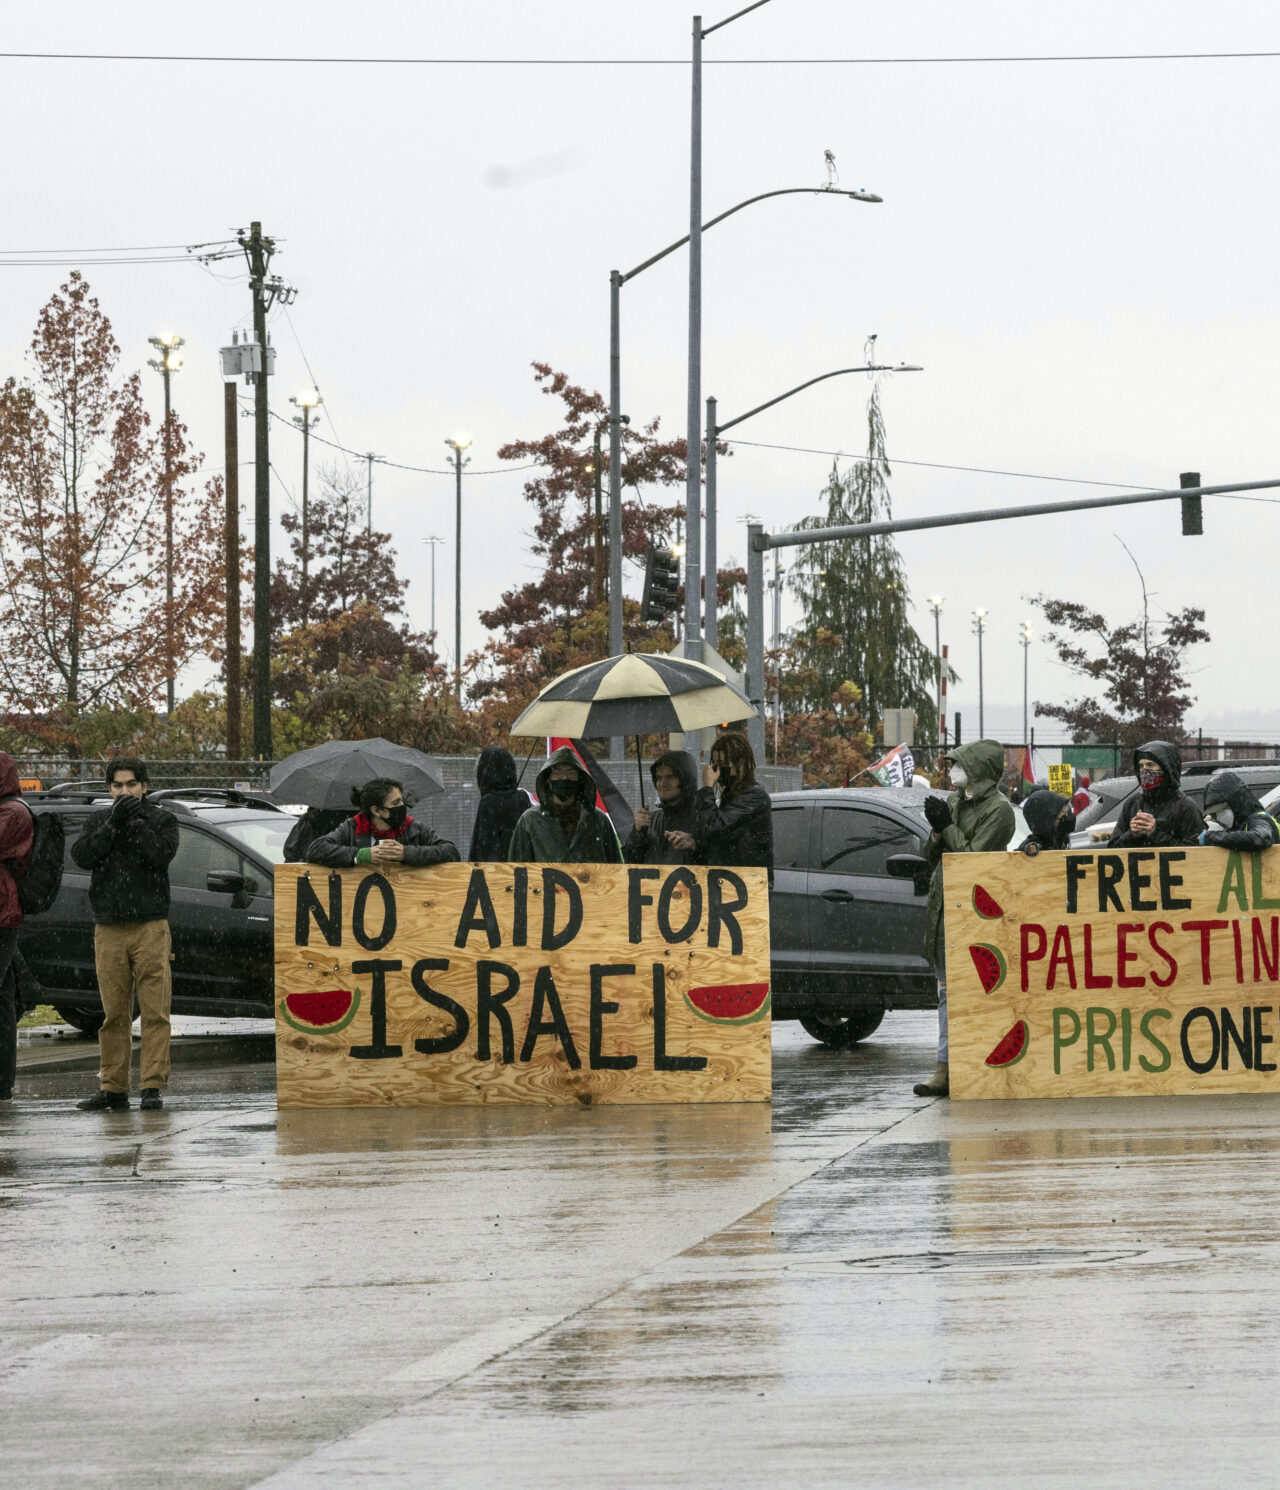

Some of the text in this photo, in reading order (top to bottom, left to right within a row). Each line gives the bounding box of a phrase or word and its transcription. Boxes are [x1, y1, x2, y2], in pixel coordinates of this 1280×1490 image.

[295, 867, 748, 955] NO AID FOR
[1065, 851, 1192, 913] FREE
[349, 959, 708, 1071] ISRAEL
